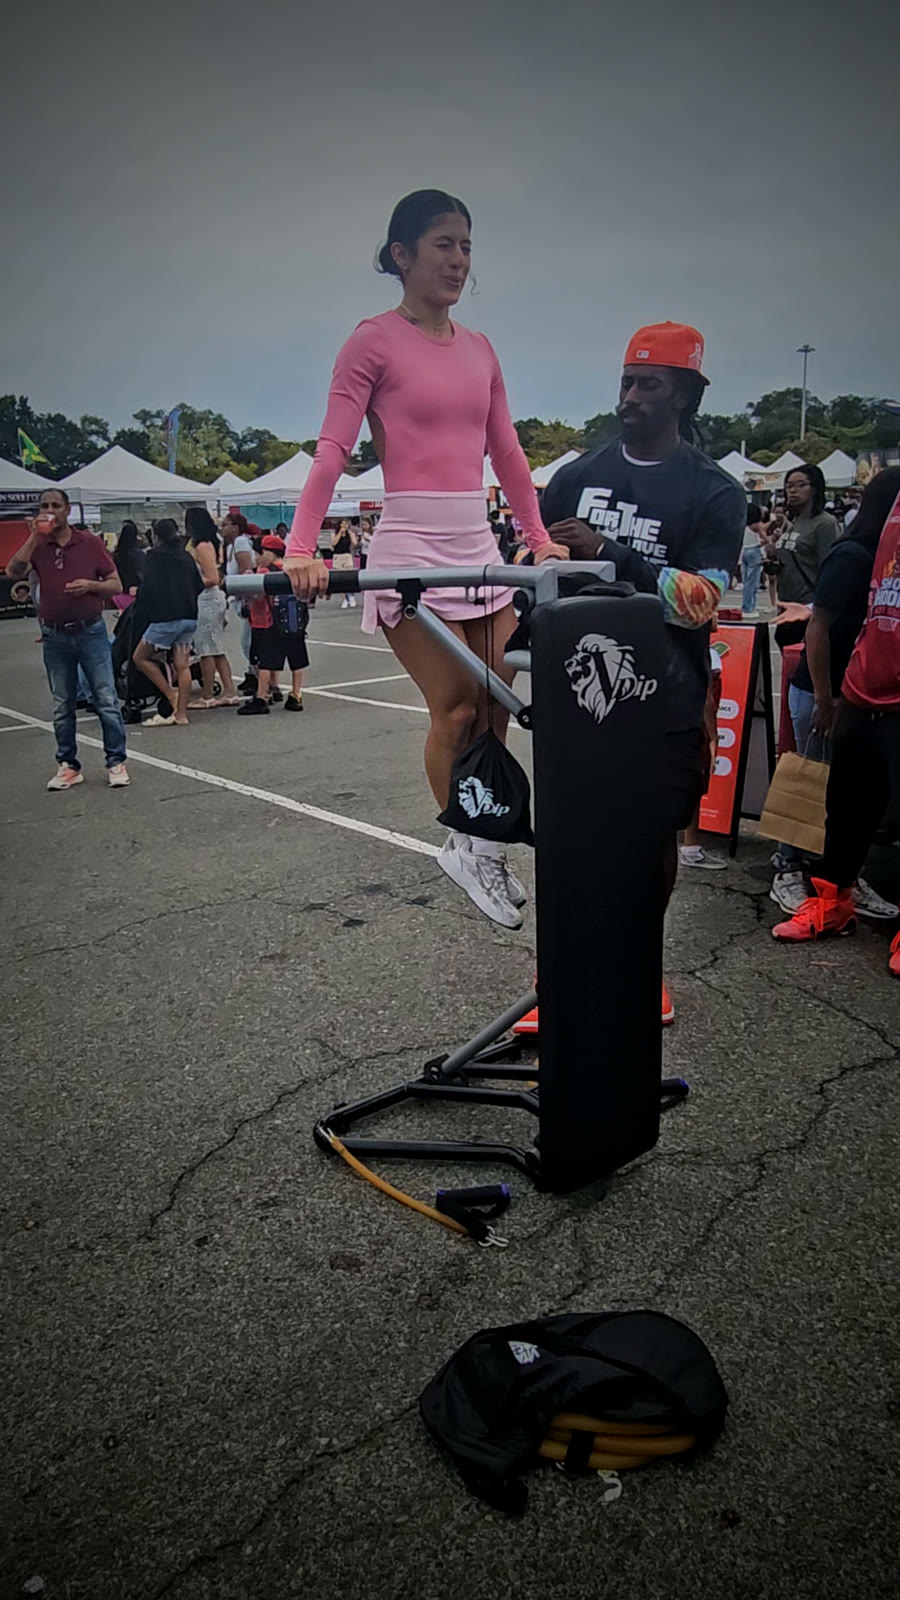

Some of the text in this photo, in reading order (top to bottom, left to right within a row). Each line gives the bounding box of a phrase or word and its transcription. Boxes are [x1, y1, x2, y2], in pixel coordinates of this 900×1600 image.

[576, 487, 662, 542] FOR THE
[881, 577, 900, 591] SHO
